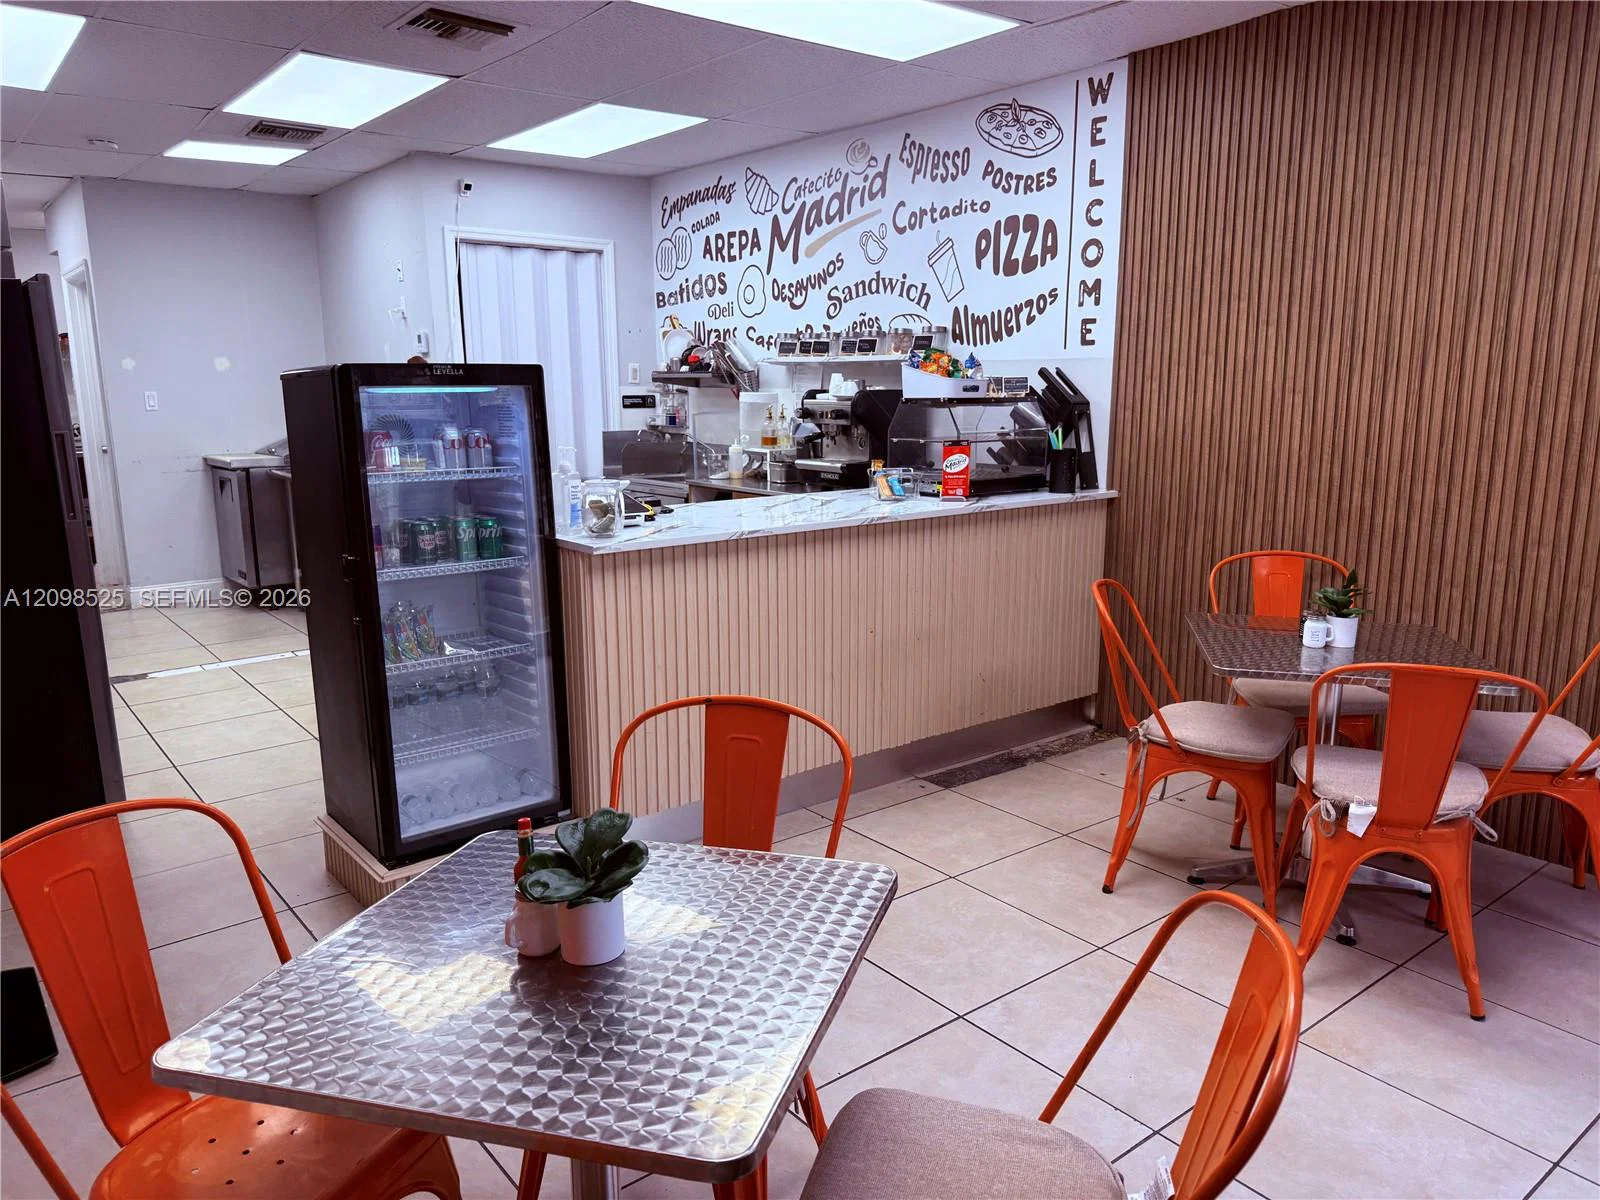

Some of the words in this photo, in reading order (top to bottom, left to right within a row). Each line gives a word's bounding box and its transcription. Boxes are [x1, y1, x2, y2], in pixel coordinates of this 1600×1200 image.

[899, 132, 970, 184] Espresso
[982, 159, 1057, 195] POSTRES
[661, 176, 736, 229] Empanadas
[766, 153, 891, 275] Madrid
[781, 167, 842, 214] Cafecito
[1078, 72, 1114, 346] WELCOME
[691, 211, 721, 234] COLADA
[892, 198, 991, 235] Cortadito
[702, 227, 762, 263] AREPA
[975, 213, 1058, 277] PIZZA
[656, 271, 728, 309] Batidos
[707, 302, 734, 320] Deli
[826, 270, 932, 320] Sandwich
[951, 287, 1059, 347] Almuerzos
